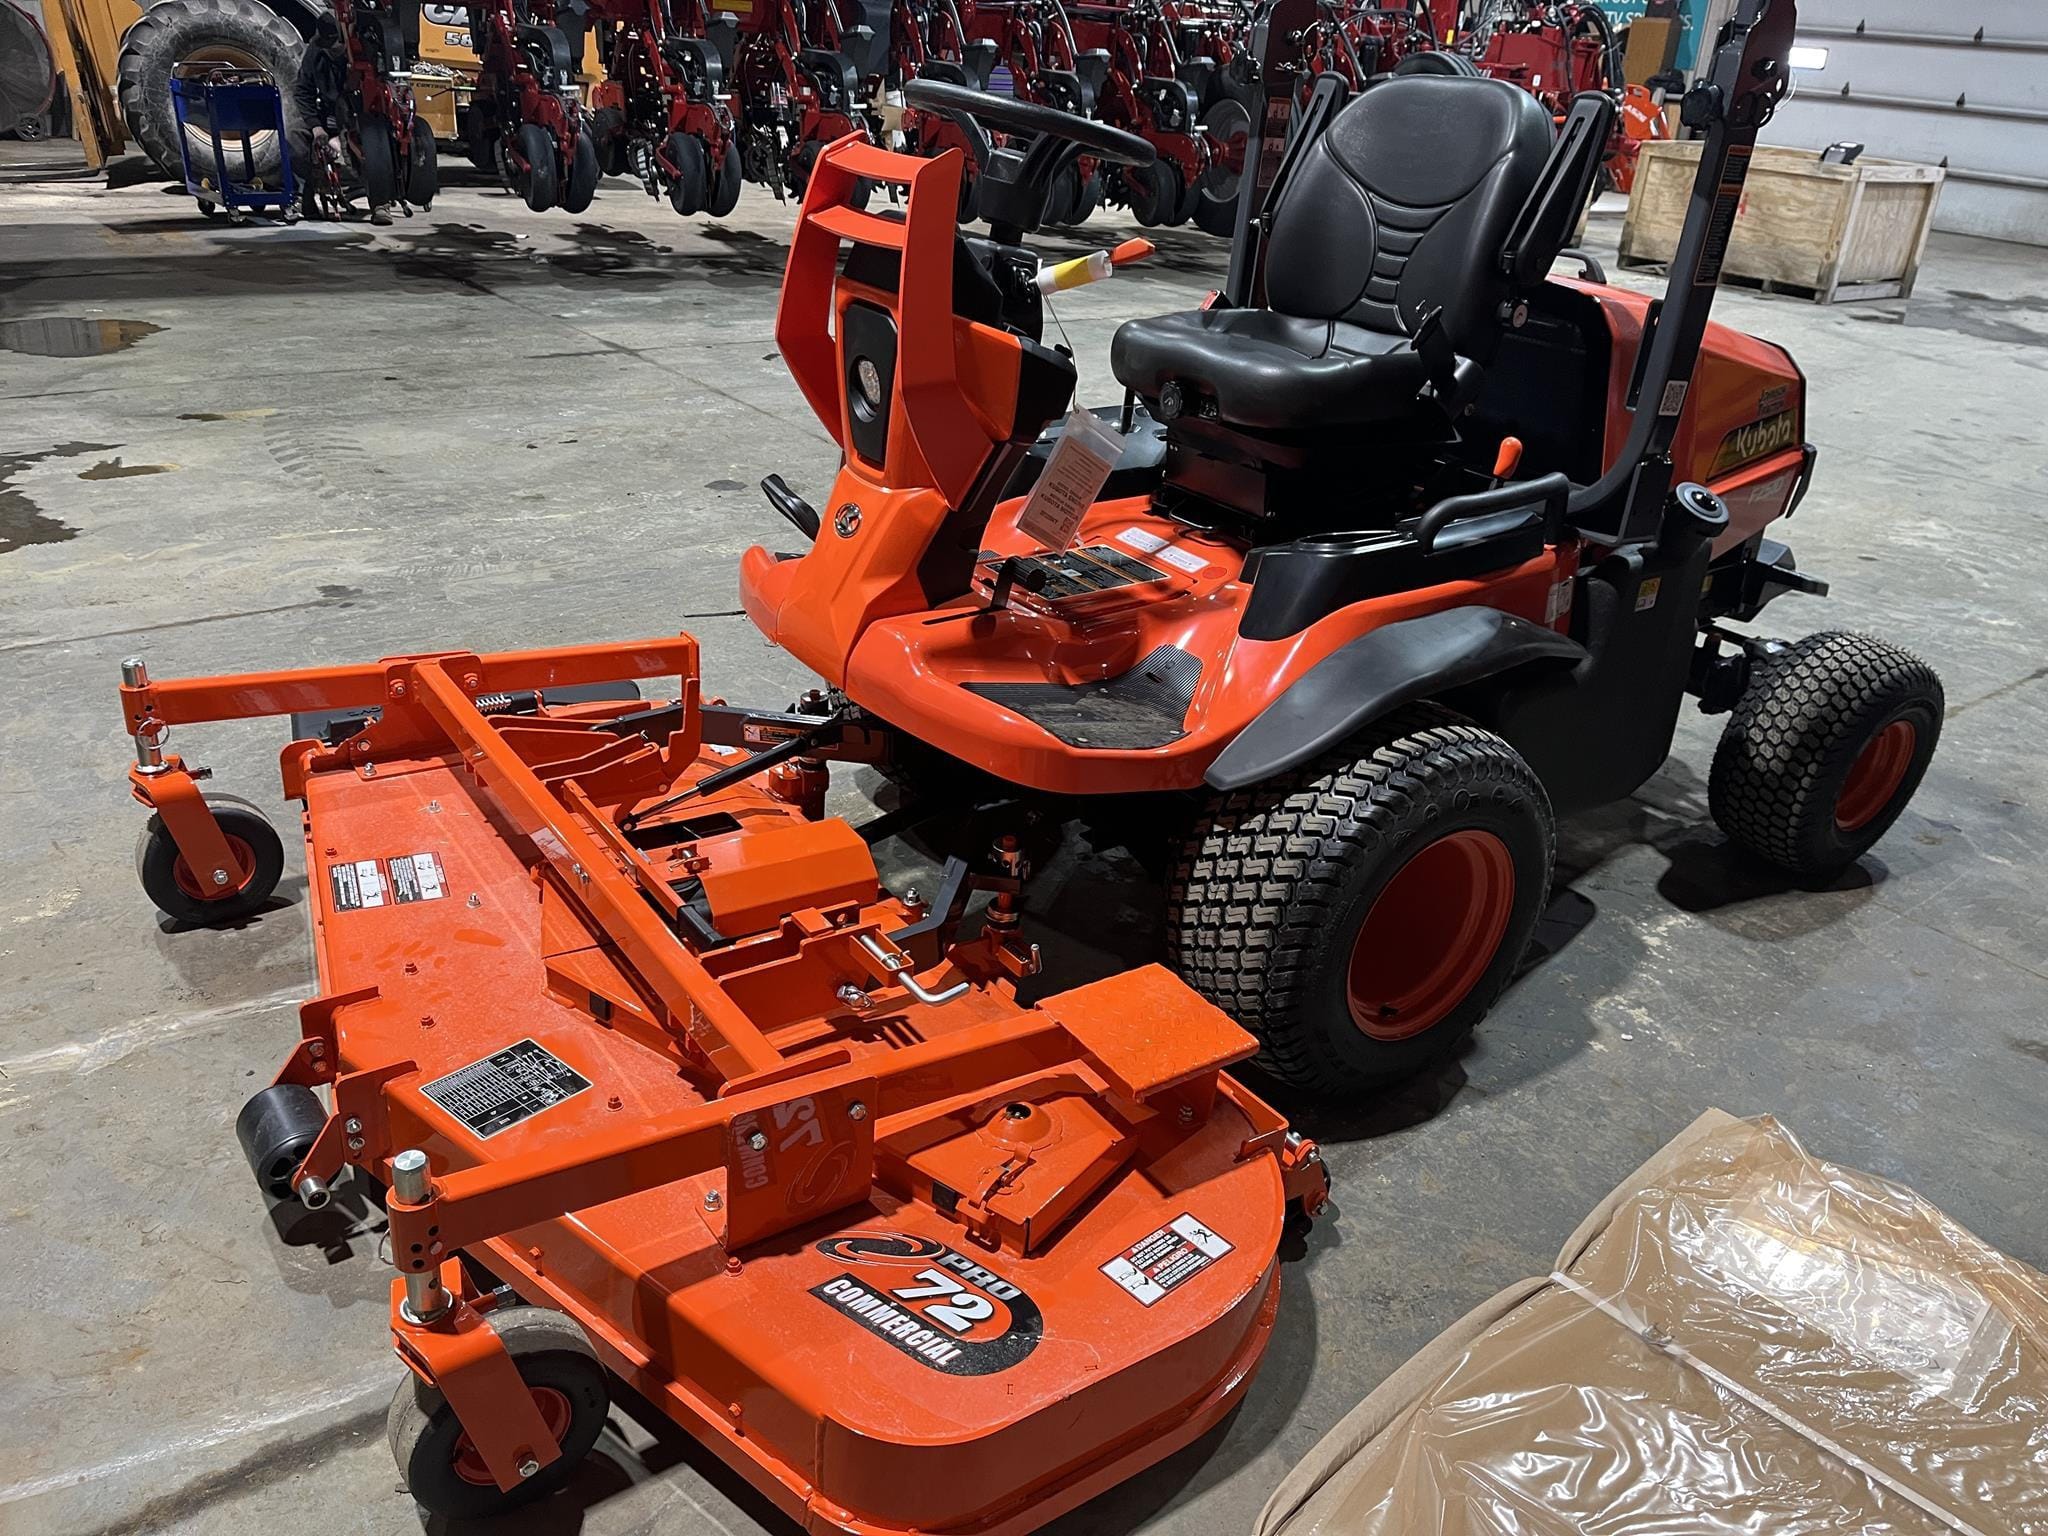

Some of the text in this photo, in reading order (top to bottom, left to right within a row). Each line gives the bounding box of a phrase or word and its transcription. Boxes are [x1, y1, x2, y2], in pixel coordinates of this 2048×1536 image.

[1736, 414, 1791, 458] Kubota
[1137, 1229, 1166, 1250] DANGER
[1157, 1247, 1189, 1270] PELIGRO
[891, 1268, 994, 1332] 72
[937, 1253, 1022, 1301] PRO
[823, 1279, 963, 1366] COMMERCIAL
